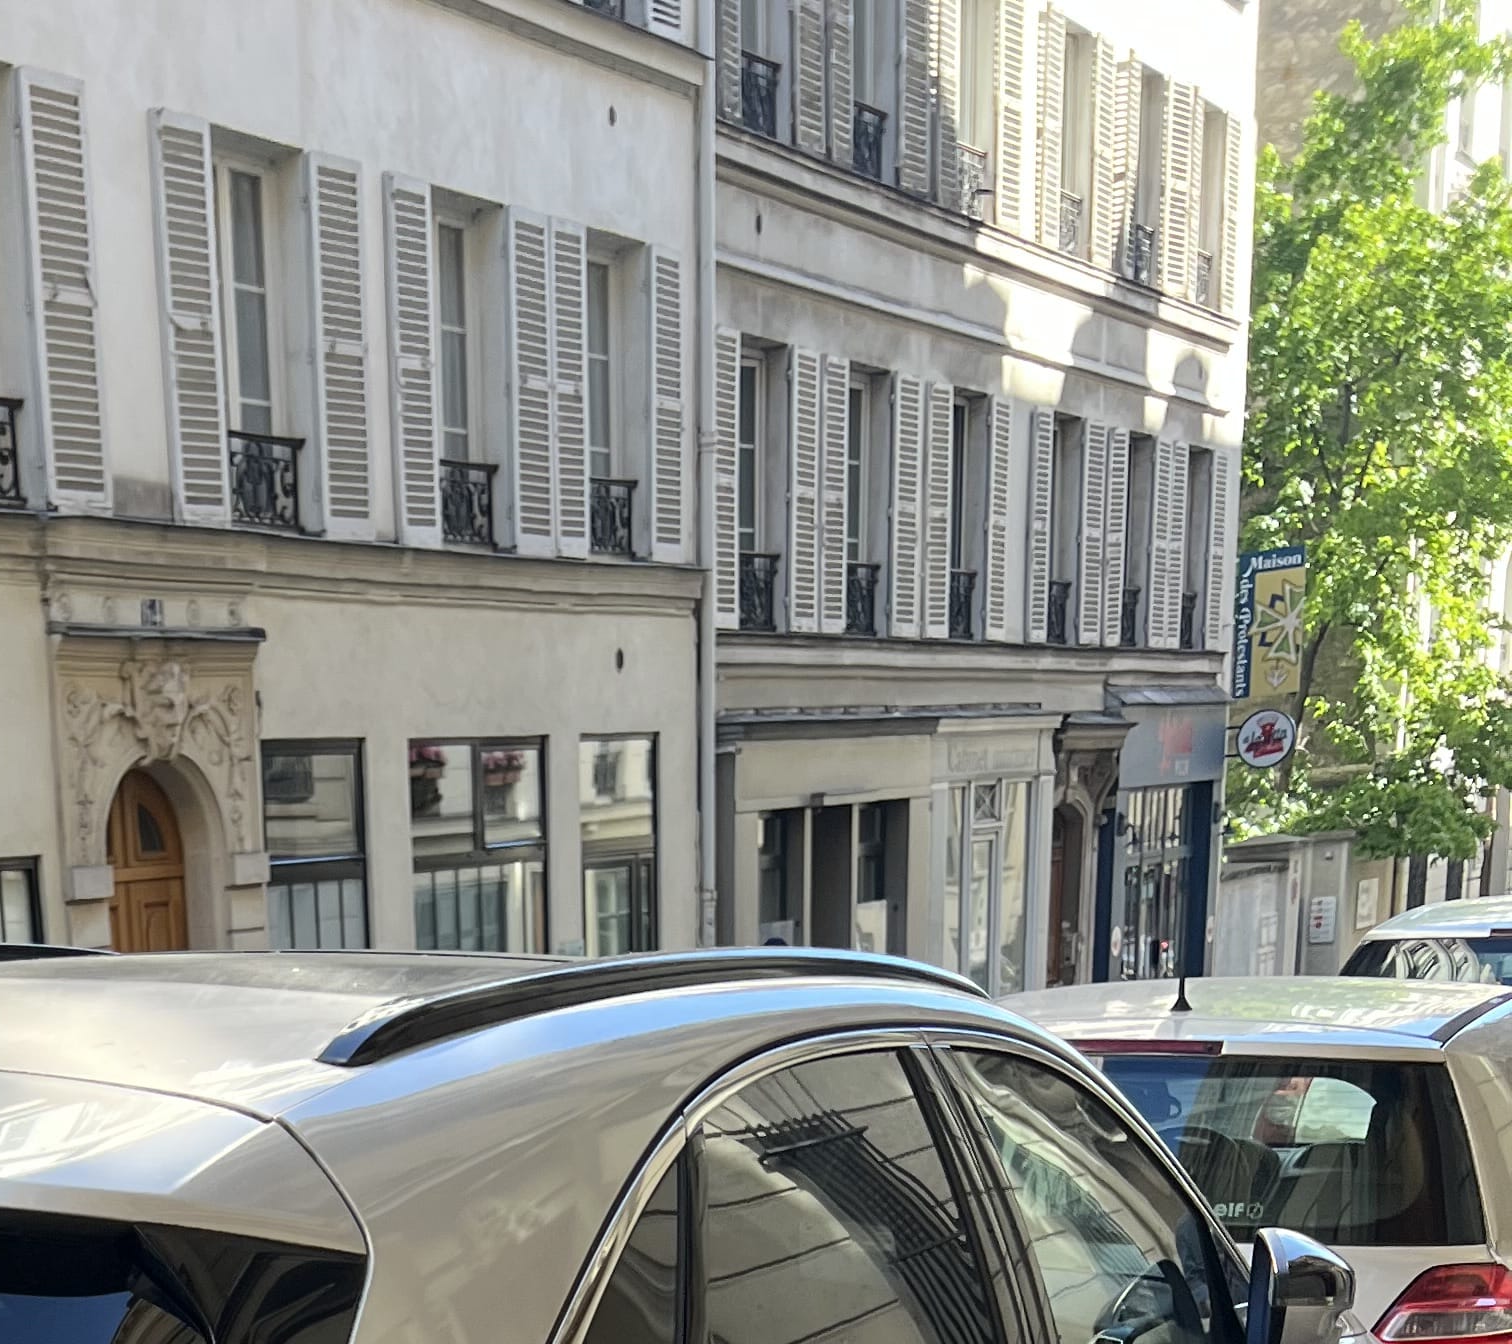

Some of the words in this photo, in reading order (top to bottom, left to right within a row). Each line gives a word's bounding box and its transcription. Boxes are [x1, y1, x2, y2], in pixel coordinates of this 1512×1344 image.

[1245, 553, 1302, 574] Maison
[1238, 580, 1253, 604] des
[1235, 607, 1252, 697] Protestants
[1213, 1202, 1245, 1218] elf
